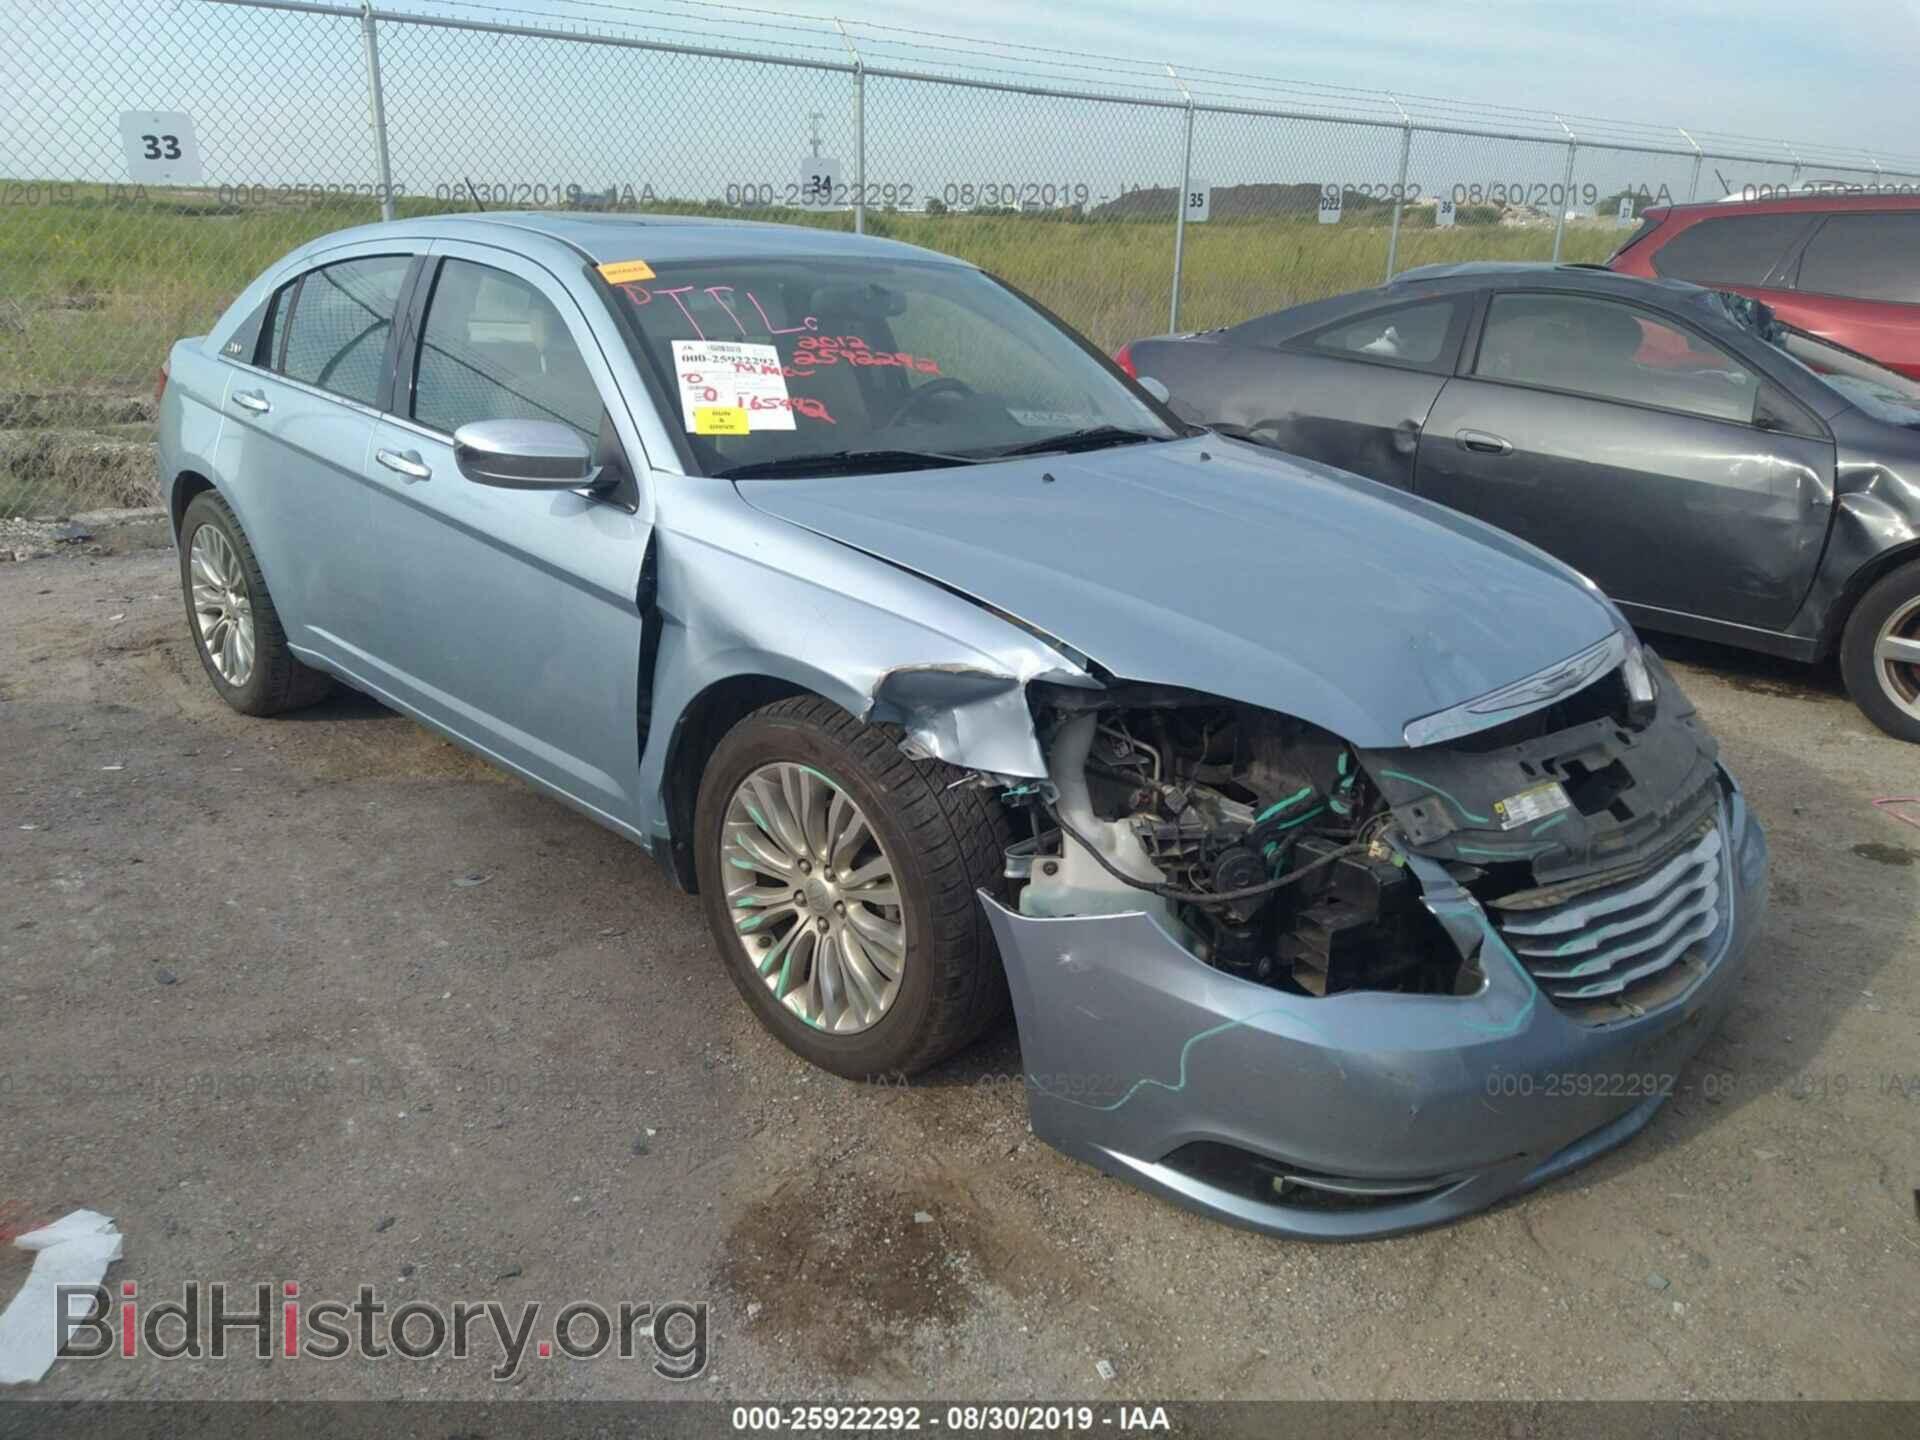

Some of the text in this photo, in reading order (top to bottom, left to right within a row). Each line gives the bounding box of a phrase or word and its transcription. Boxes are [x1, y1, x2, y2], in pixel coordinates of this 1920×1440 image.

[141, 134, 182, 161] 33
[811, 174, 832, 194] 34
[1189, 193, 1204, 207] 35
